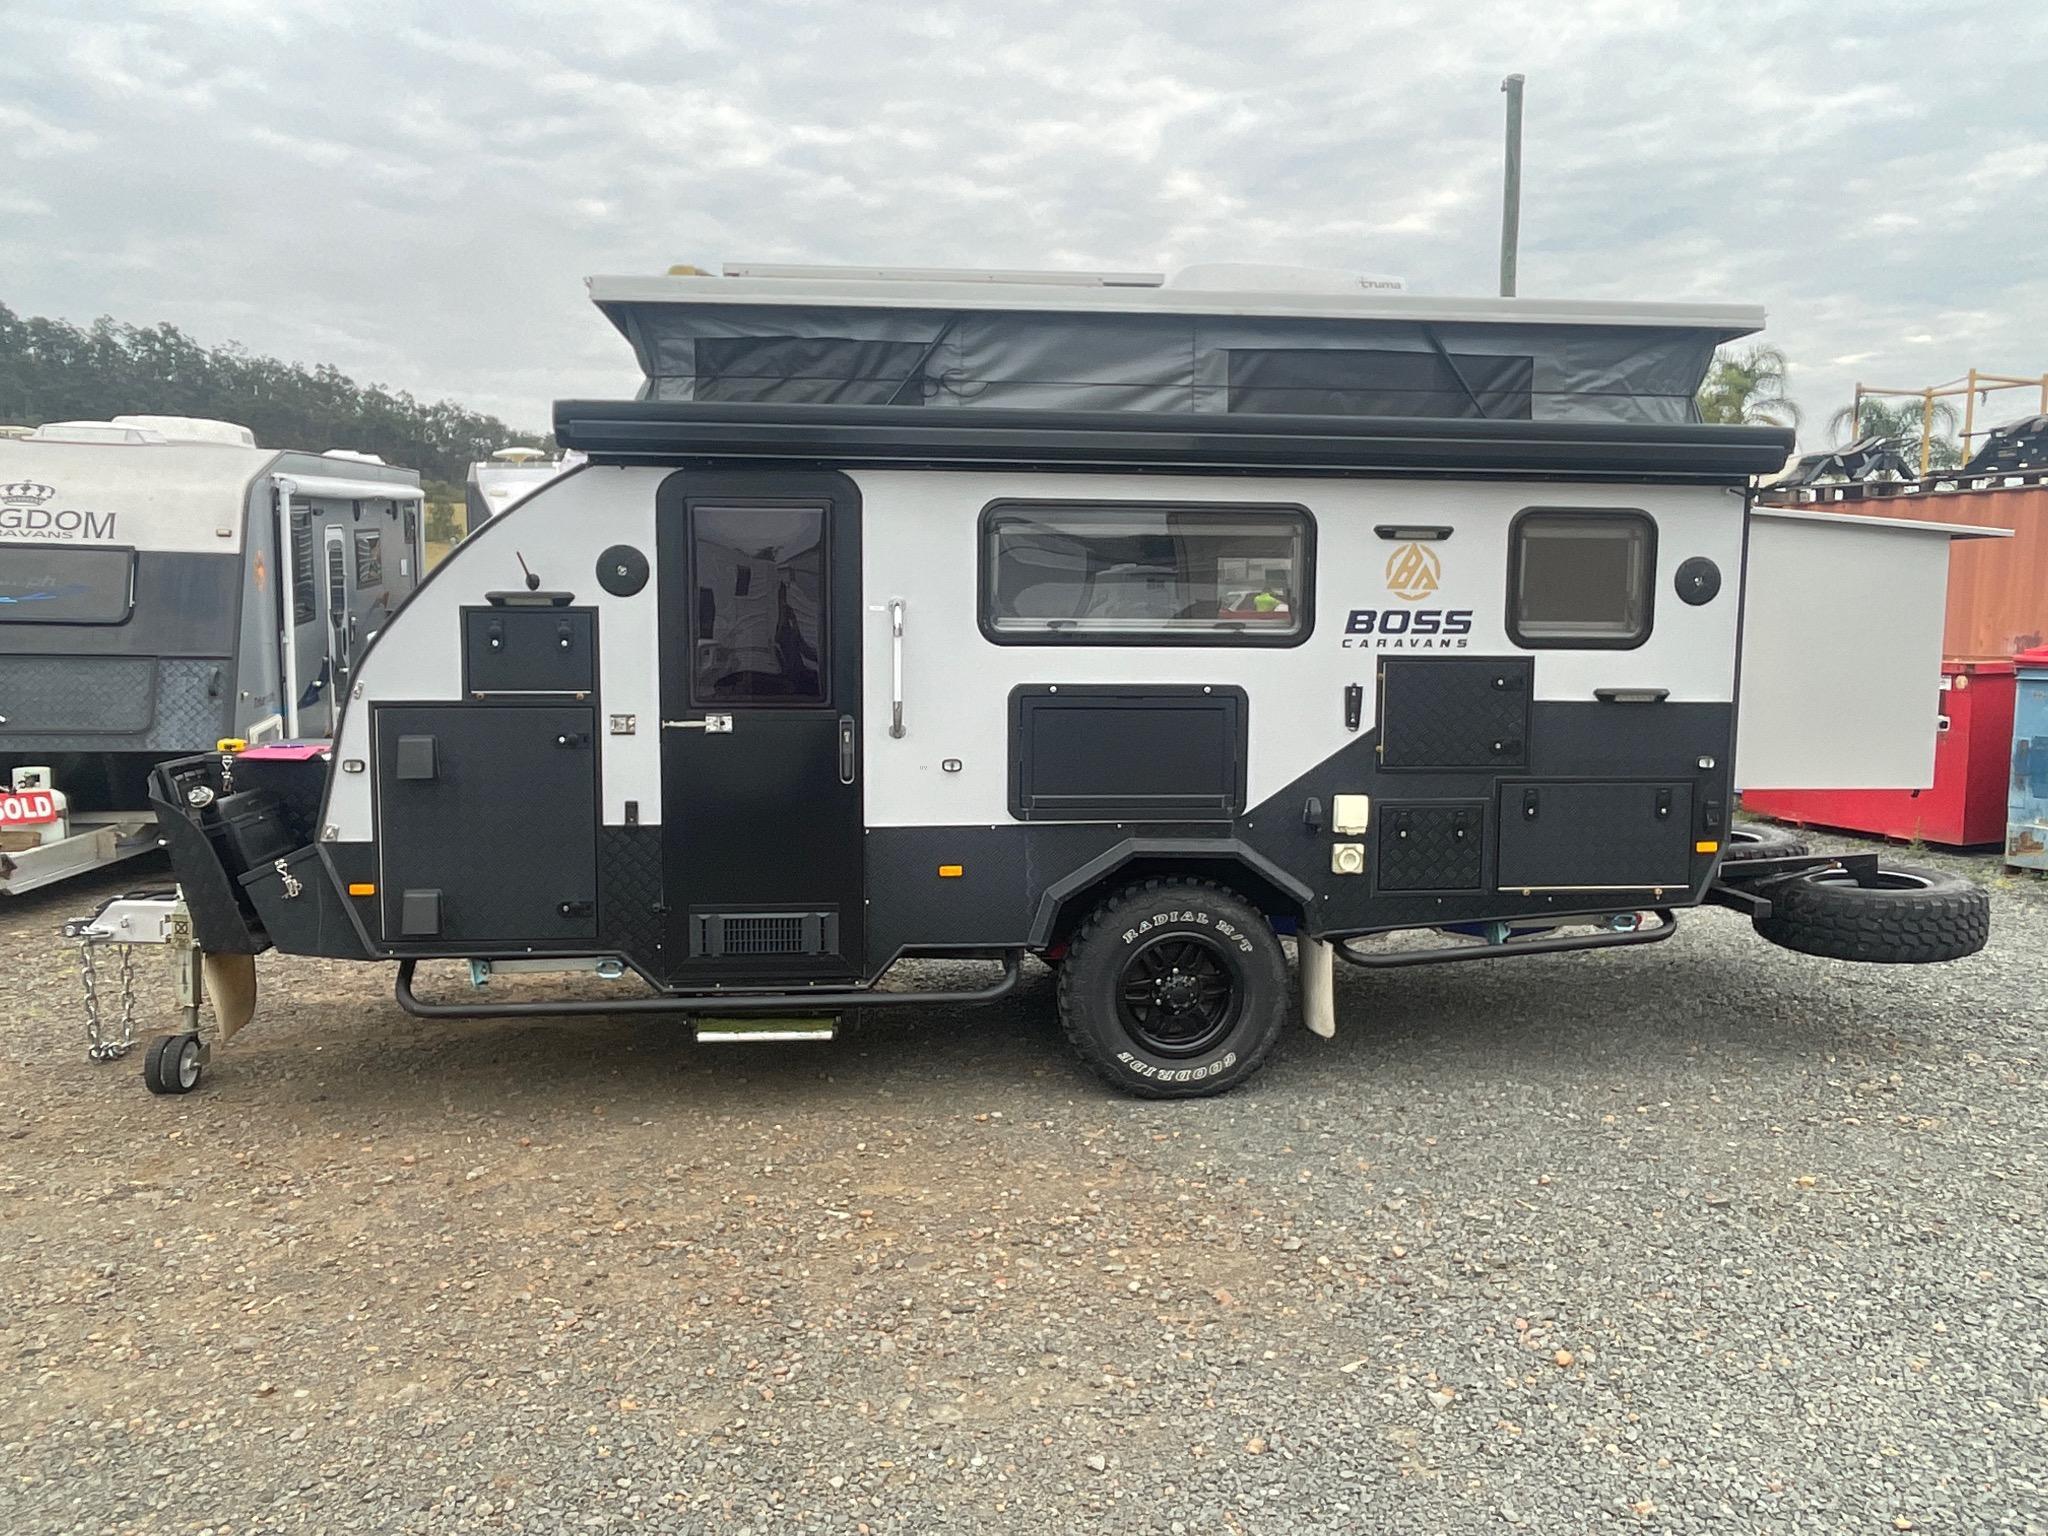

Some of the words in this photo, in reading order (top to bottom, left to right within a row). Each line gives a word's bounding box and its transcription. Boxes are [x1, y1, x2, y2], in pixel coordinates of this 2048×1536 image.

[1358, 276, 1402, 290] truma
[1344, 610, 1474, 635] BOSS
[1342, 638, 1468, 649] CARAVANS
[1122, 911, 1209, 944] RADIAL
[1215, 919, 1253, 952] M/T
[1116, 1052, 1237, 1081] GOODRIDE
